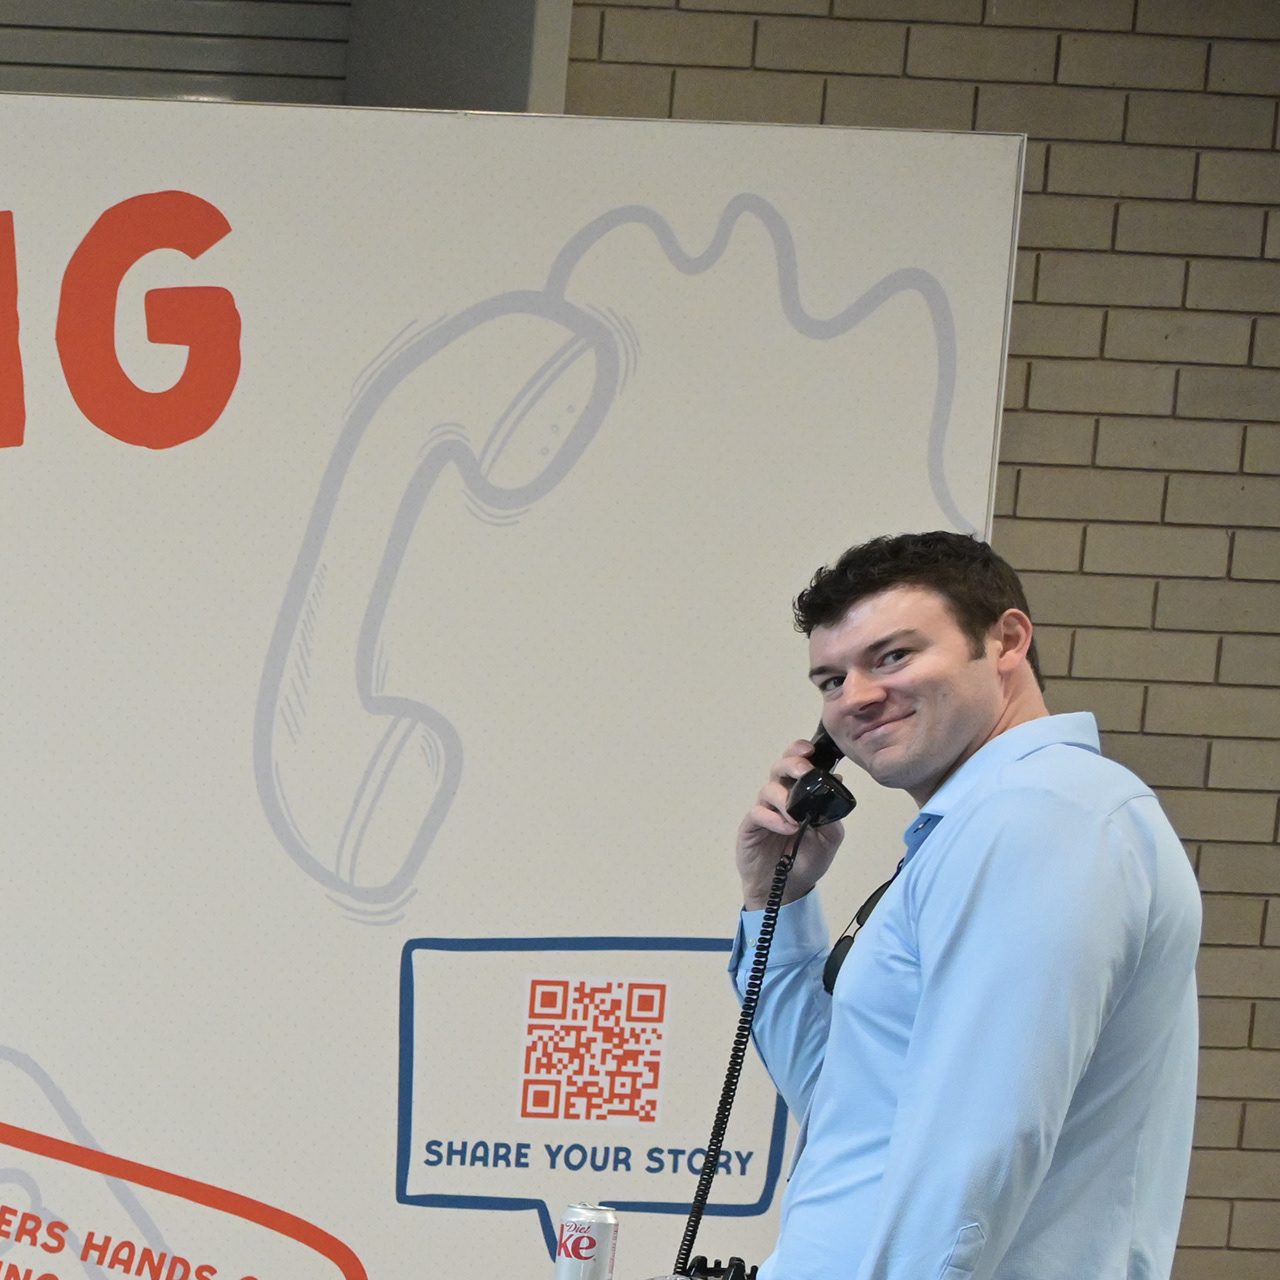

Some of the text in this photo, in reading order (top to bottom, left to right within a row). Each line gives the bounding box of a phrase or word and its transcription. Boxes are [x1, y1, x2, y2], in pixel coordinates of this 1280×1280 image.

[426, 1141, 754, 1177] SHARE YOUR STORY
[558, 1224, 596, 1260] ke
[565, 1222, 591, 1234] Diet
